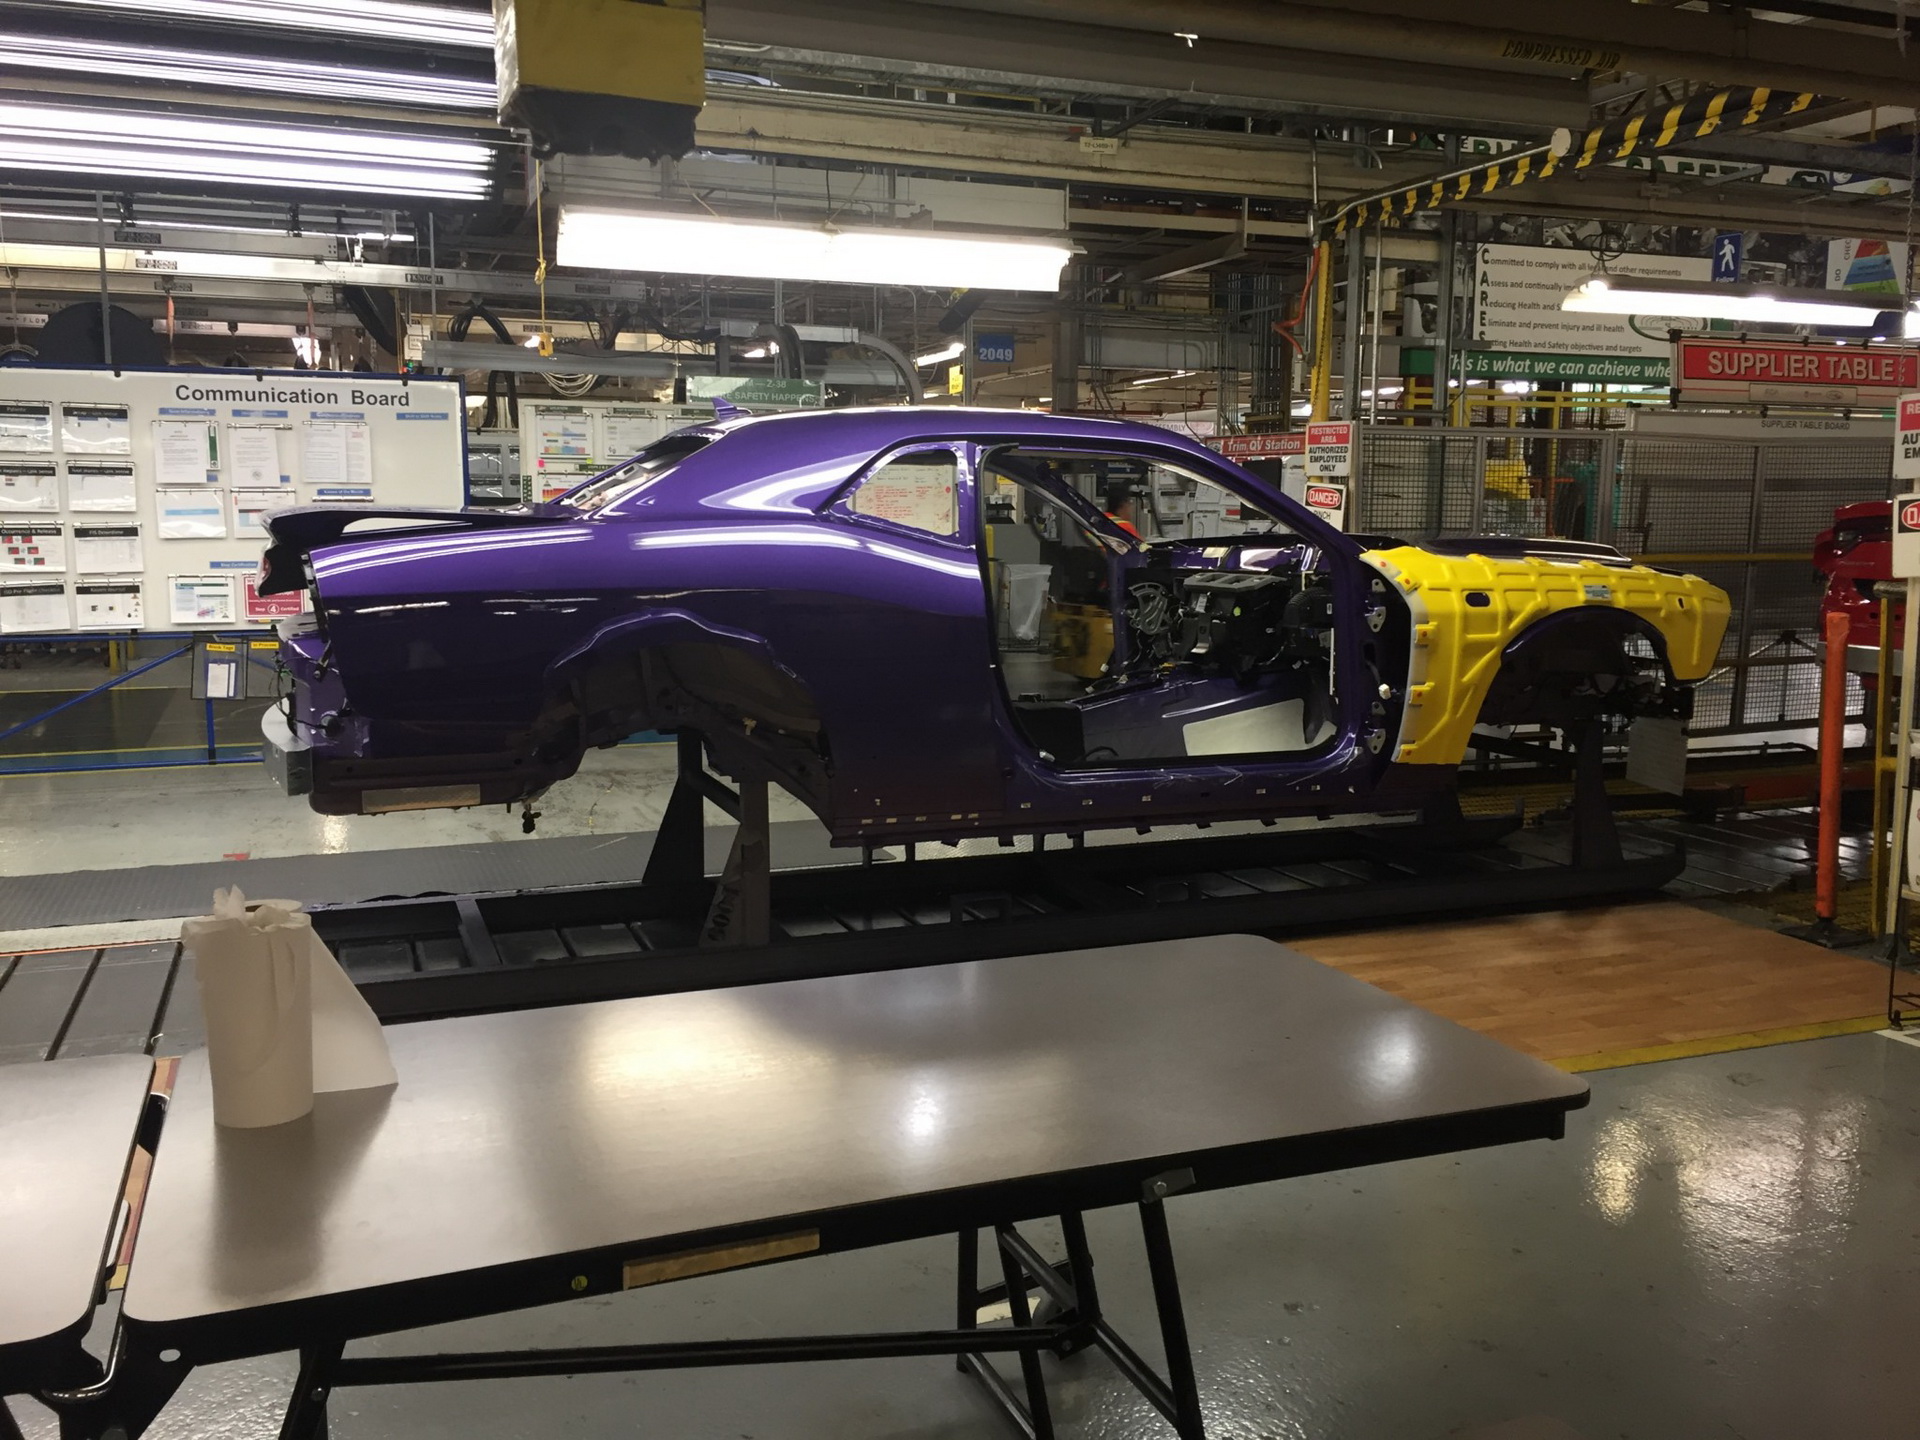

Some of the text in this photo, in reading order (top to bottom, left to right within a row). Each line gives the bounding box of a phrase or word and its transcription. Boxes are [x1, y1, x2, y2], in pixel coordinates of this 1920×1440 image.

[1502, 39, 1620, 69] COMPRESSED AIR
[1526, 259, 1534, 267] to
[1535, 260, 1559, 270] comply
[1561, 262, 1577, 270] with
[1578, 263, 1586, 271] all
[1638, 267, 1682, 277] requirements
[1510, 281, 1523, 289] and
[1525, 282, 1562, 292] continually
[1518, 301, 1541, 310] Health
[1542, 303, 1555, 311] and
[1518, 320, 1532, 329] and
[1533, 322, 1559, 330] prevent
[1561, 323, 1580, 332] injury
[1582, 323, 1595, 331] and
[1603, 324, 1625, 333] health
[1509, 340, 1532, 348] Health
[1548, 341, 1569, 351] Safety
[1570, 342, 1604, 352] objectives
[1605, 343, 1618, 351] and
[1619, 345, 1642, 354] targets
[979, 347, 1013, 361] 2049
[1476, 356, 1489, 372] is
[1492, 355, 1531, 373] what
[1534, 361, 1557, 374] we
[1558, 361, 1585, 375] can
[1587, 360, 1641, 377] achieve
[1708, 350, 1894, 381] SUPPLIER TABLE
[766, 379, 787, 388] Z-38
[175, 384, 410, 407] Communication Board
[735, 392, 769, 401] SAFETY
[771, 393, 815, 403] HAPPENS
[1310, 426, 1348, 435] RESTRICTED
[1761, 419, 1850, 431] SUPPLIER TABLE BOARD
[1228, 438, 1300, 452] Trim QV Station
[1320, 435, 1337, 443] AREA
[1309, 445, 1349, 454] AUTHORIZED
[1309, 455, 1347, 463] EMPLOYEES
[1319, 464, 1336, 472] ONLY
[1309, 490, 1340, 505] DANGER
